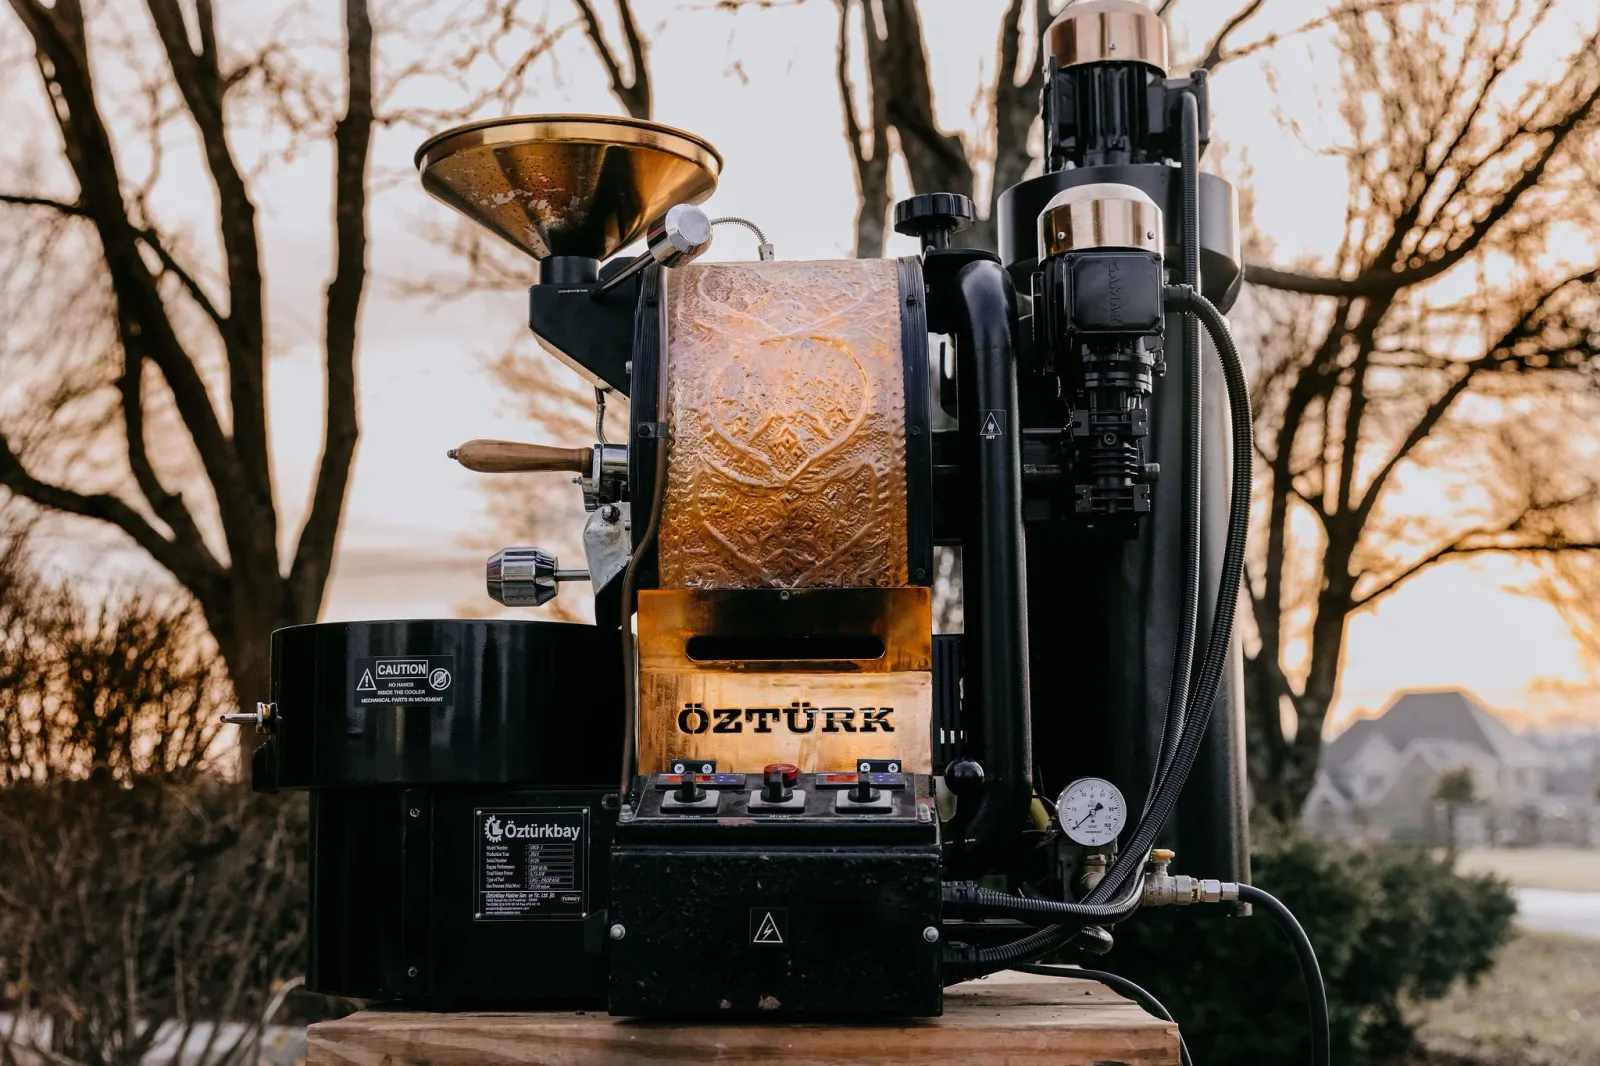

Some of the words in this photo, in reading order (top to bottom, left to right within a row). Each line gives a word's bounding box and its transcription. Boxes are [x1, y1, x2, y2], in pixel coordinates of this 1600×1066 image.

[378, 664, 426, 675] CAUTION
[677, 700, 895, 734] ÖZTÜRK
[504, 820, 580, 841] Öztürkbay
